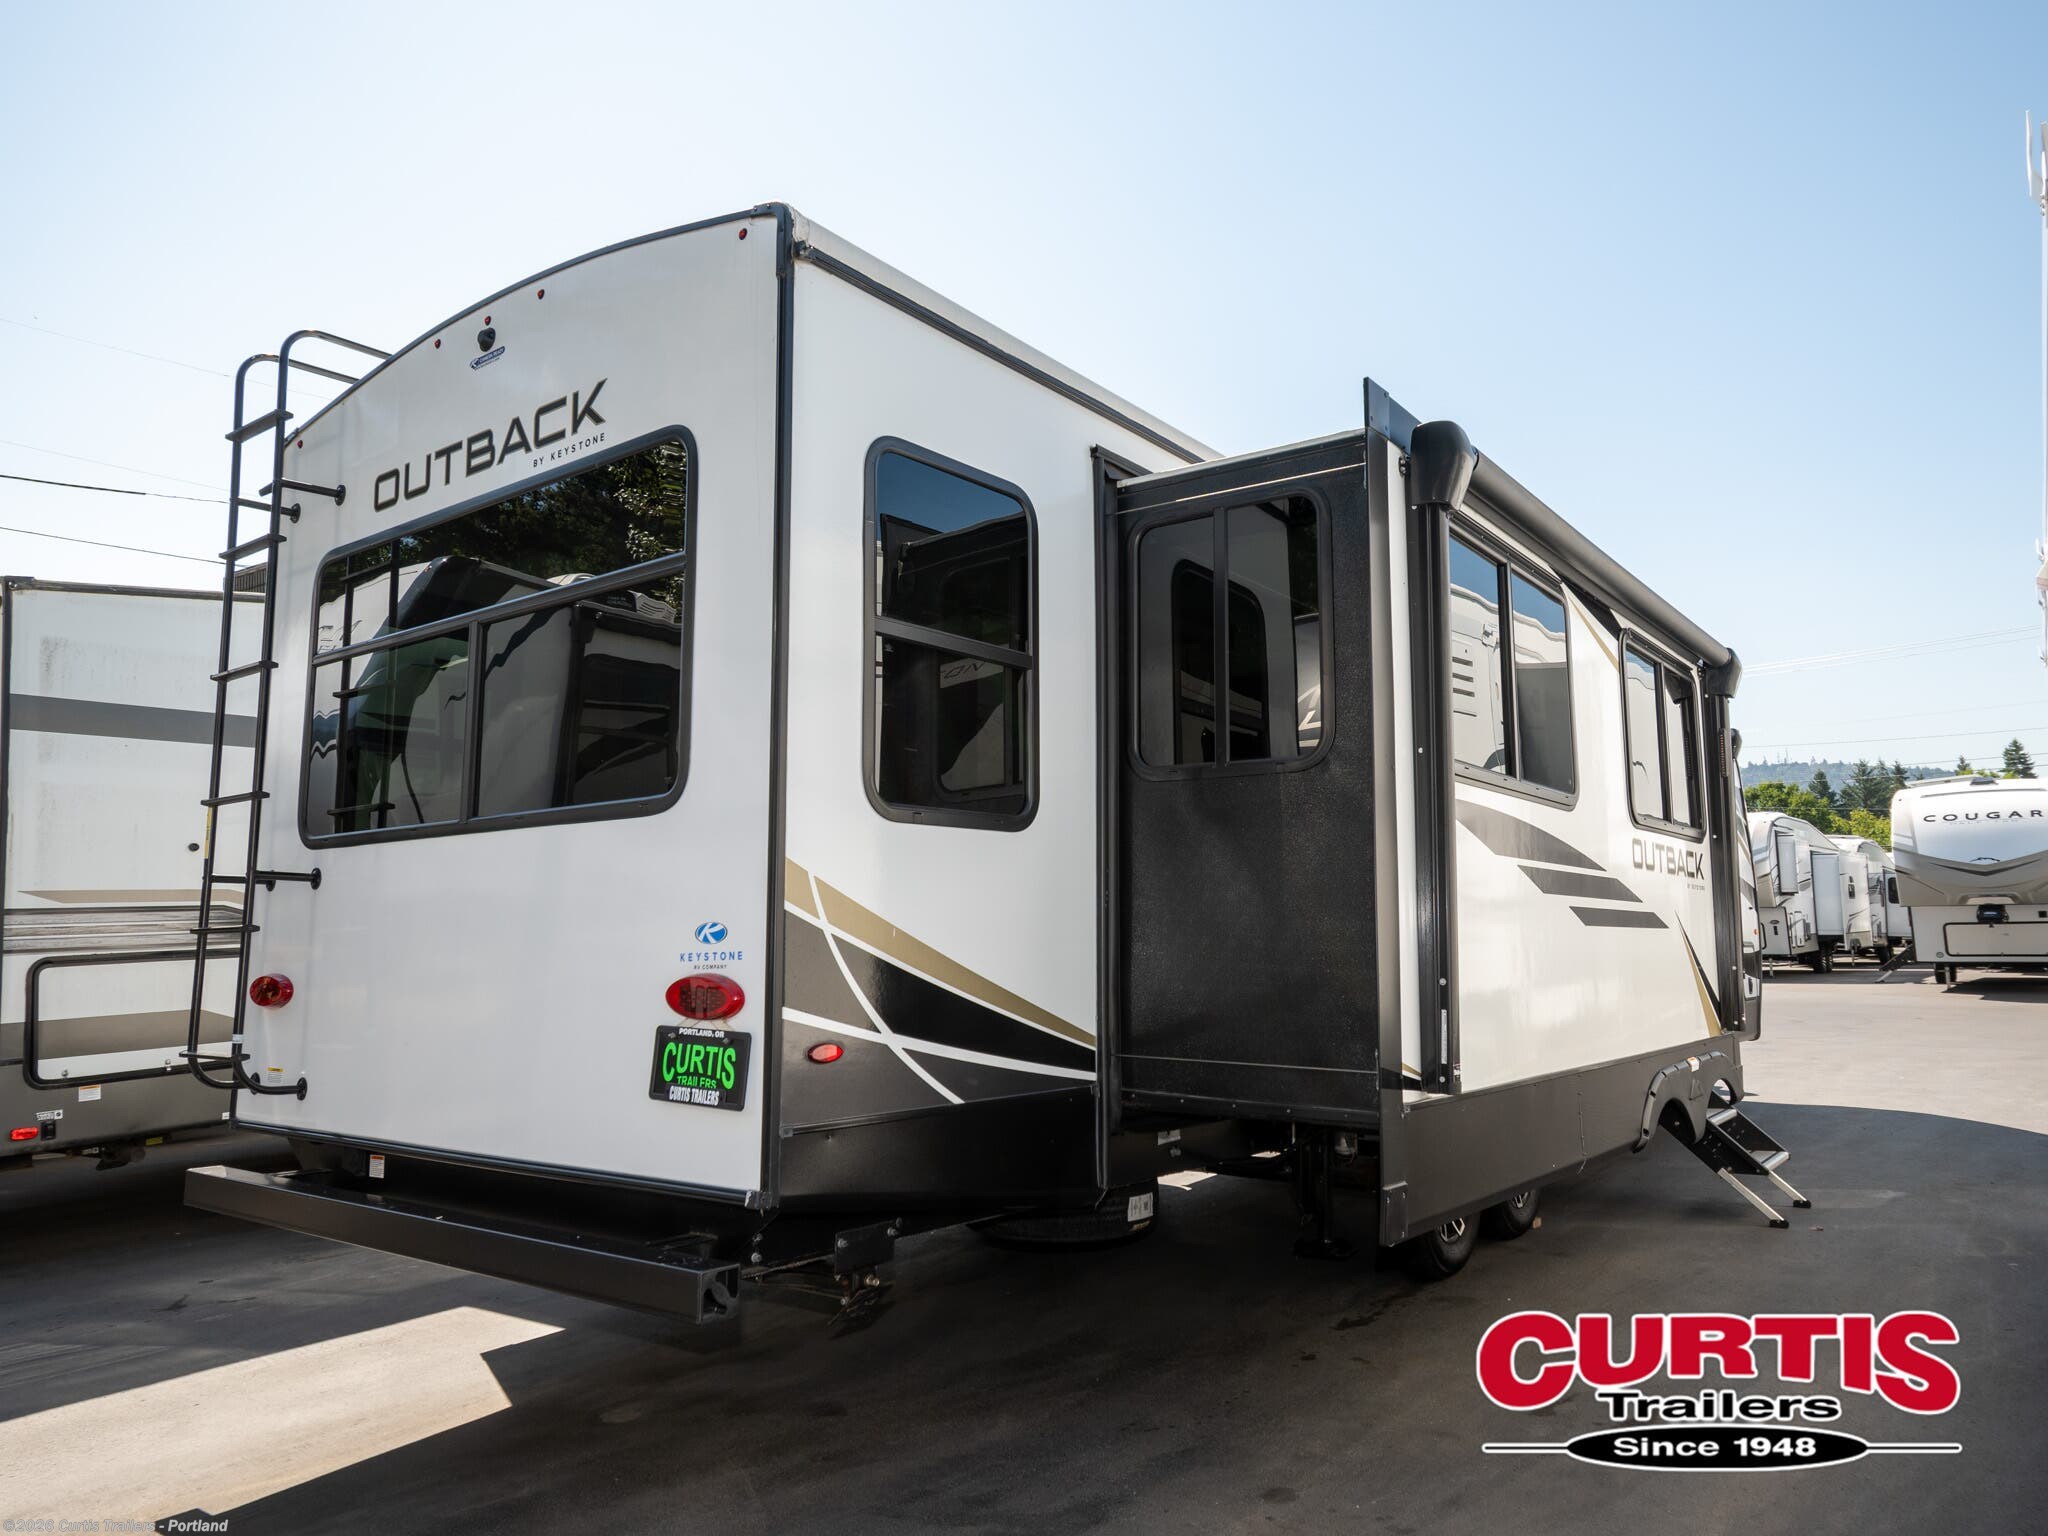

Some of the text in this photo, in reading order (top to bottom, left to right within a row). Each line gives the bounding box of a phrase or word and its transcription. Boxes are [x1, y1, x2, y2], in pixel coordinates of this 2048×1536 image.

[373, 378, 608, 513] OUTBACK
[533, 432, 606, 468] BY KEYSTONE
[1923, 809, 2044, 823] COUGAR
[1632, 838, 1705, 880] OUTBACK
[679, 950, 743, 962] KEYSTONE
[679, 1027, 725, 1038] PORTLAND, OR
[662, 1041, 737, 1090] CURTIS
[669, 1085, 720, 1106] CURTIS TRAILERS
